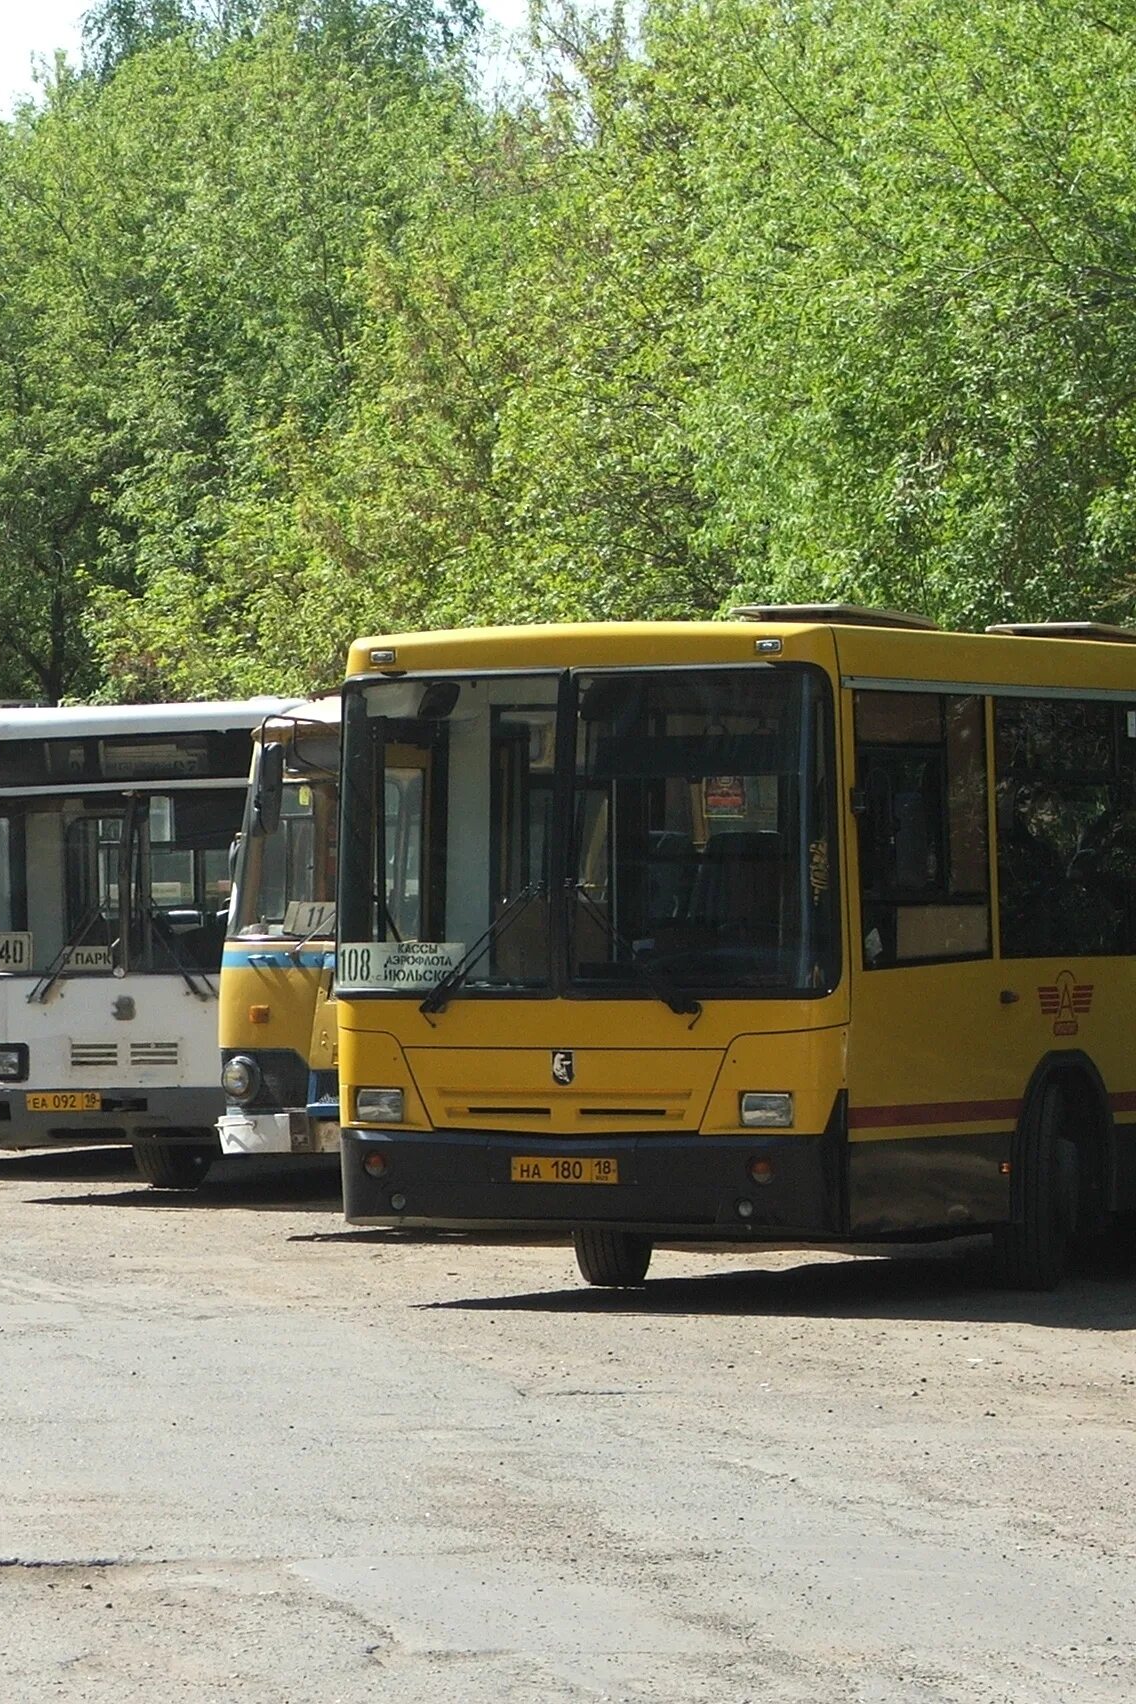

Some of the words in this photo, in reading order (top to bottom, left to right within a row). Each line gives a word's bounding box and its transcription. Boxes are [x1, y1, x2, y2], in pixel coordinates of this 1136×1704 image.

[308, 906, 325, 929] 11
[397, 944, 439, 954] КАССЫ
[75, 952, 113, 965] ПАРК
[340, 948, 371, 981] 108
[385, 955, 453, 967] АЭРОФЛОТА
[32, 1097, 49, 1109] ЕА
[52, 1095, 77, 1109] 092
[519, 1163, 542, 1179] НА
[551, 1160, 583, 1180] 180
[594, 1160, 612, 1175] 18
